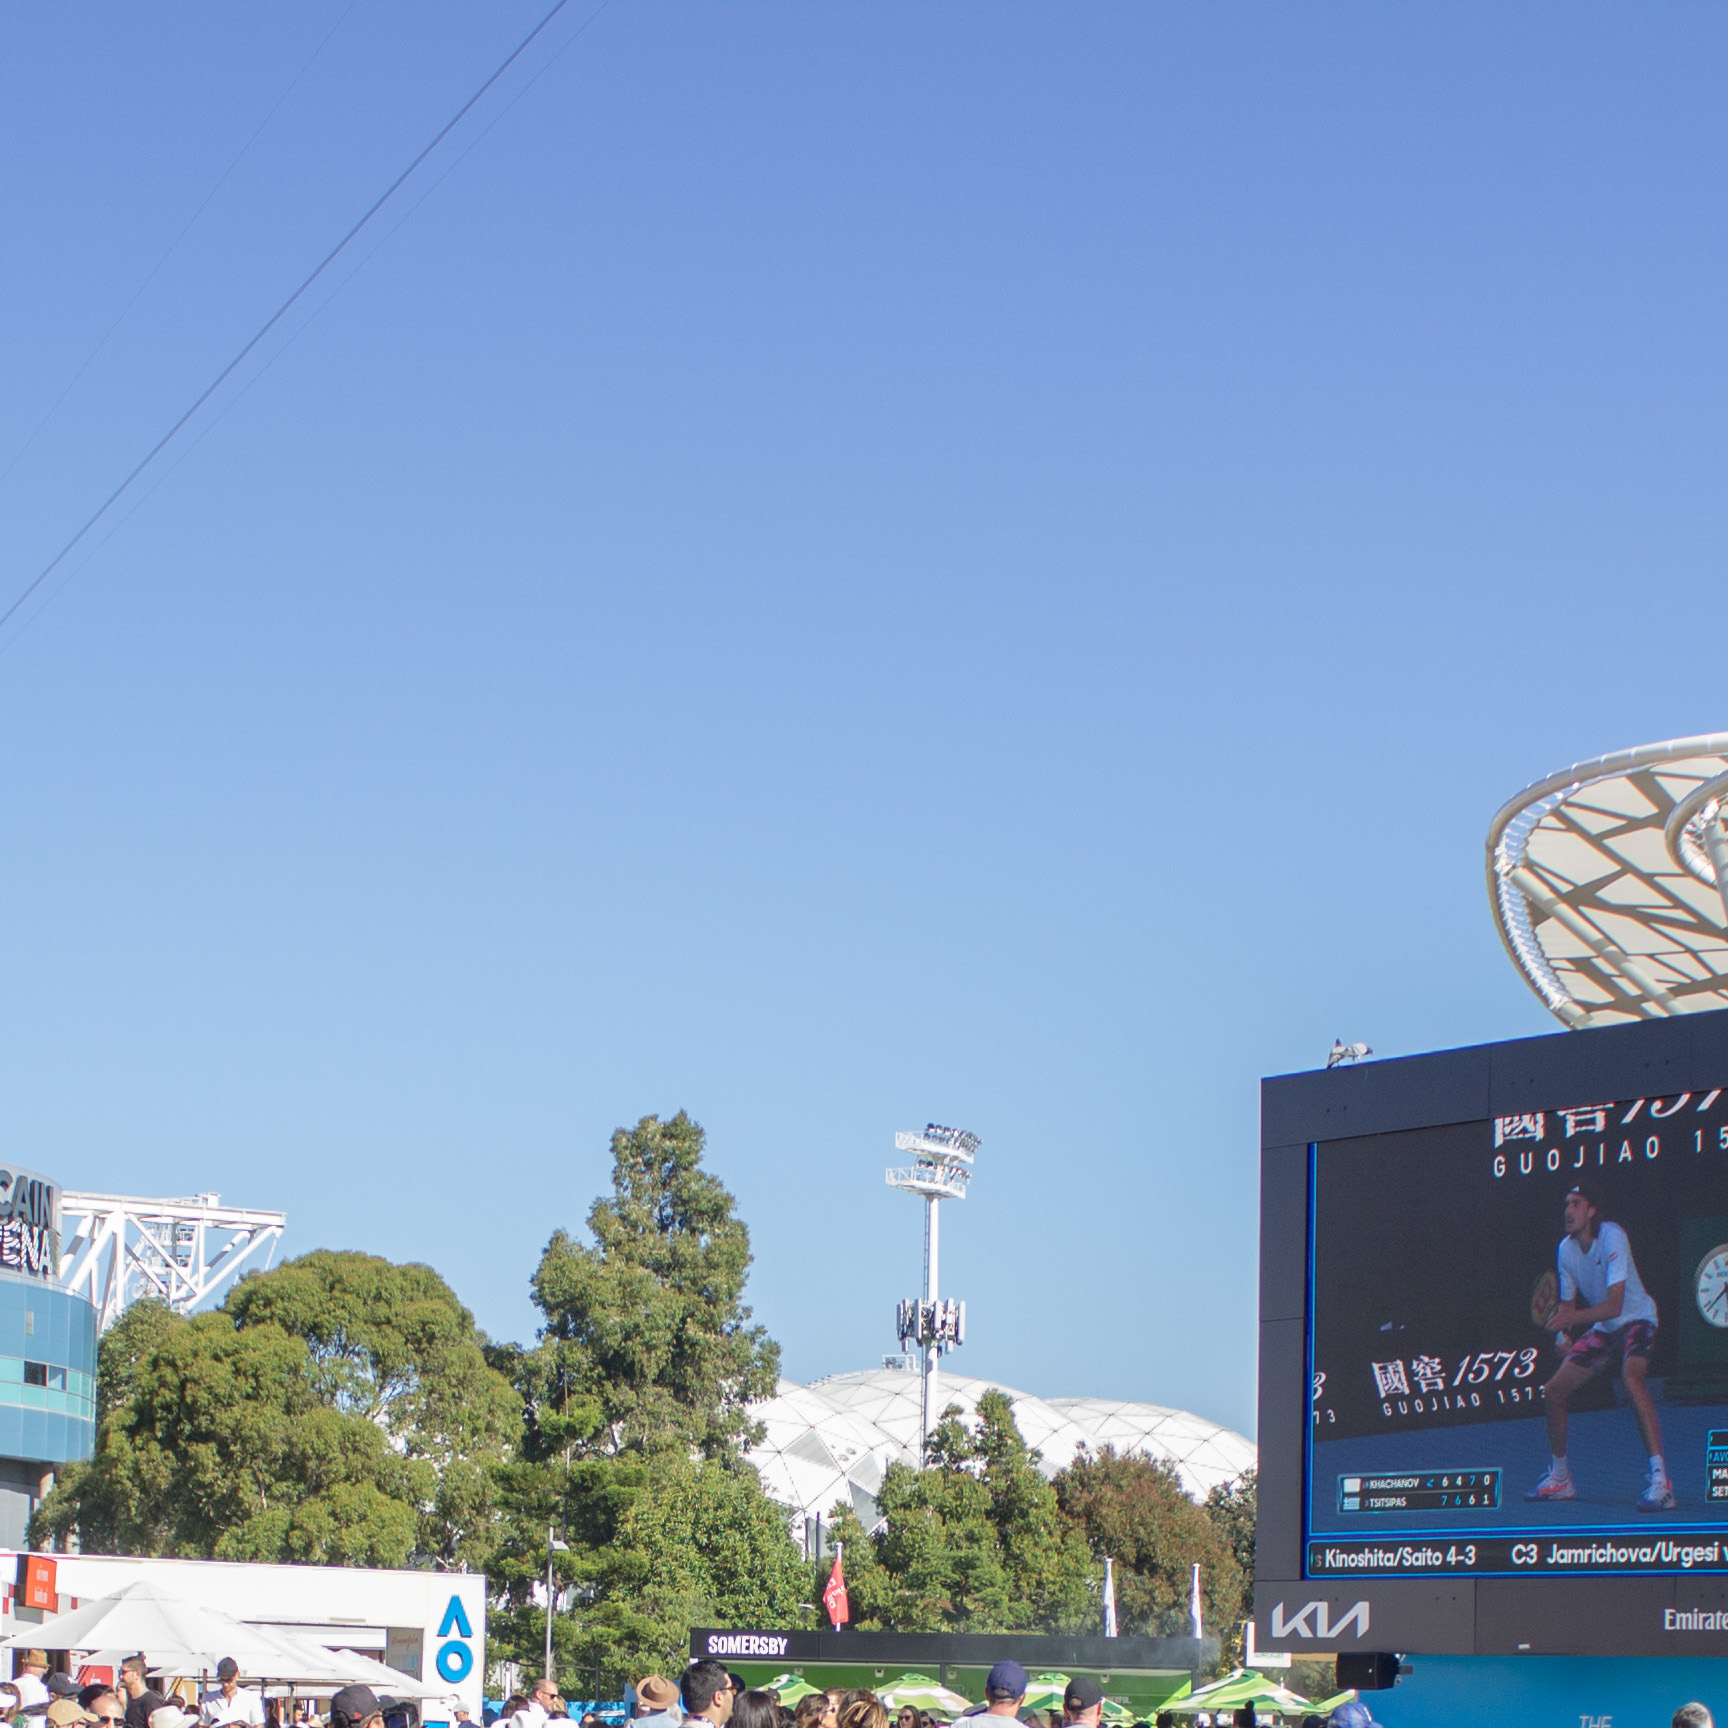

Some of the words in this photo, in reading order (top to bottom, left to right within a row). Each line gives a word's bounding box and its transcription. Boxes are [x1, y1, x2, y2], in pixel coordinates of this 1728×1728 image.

[1493, 1136, 1661, 1178] GUOJIAO
[1383, 1395, 1481, 1417] GUOJIAO
[1370, 1477, 1420, 1489] KHACHANOV
[1456, 1476, 1462, 1487] 4
[1470, 1475, 1476, 1486] 7
[1370, 1497, 1408, 1508] TSITSIPAS
[1325, 1546, 1442, 1568] Kinoshita/Saito
[1446, 1545, 1476, 1566] 4-3
[1511, 1543, 1537, 1565] C3
[1546, 1541, 1719, 1567] Jamrichova/Urgesi
[1271, 1601, 1370, 1639] KIA
[708, 1634, 788, 1656] SOMERSBY
